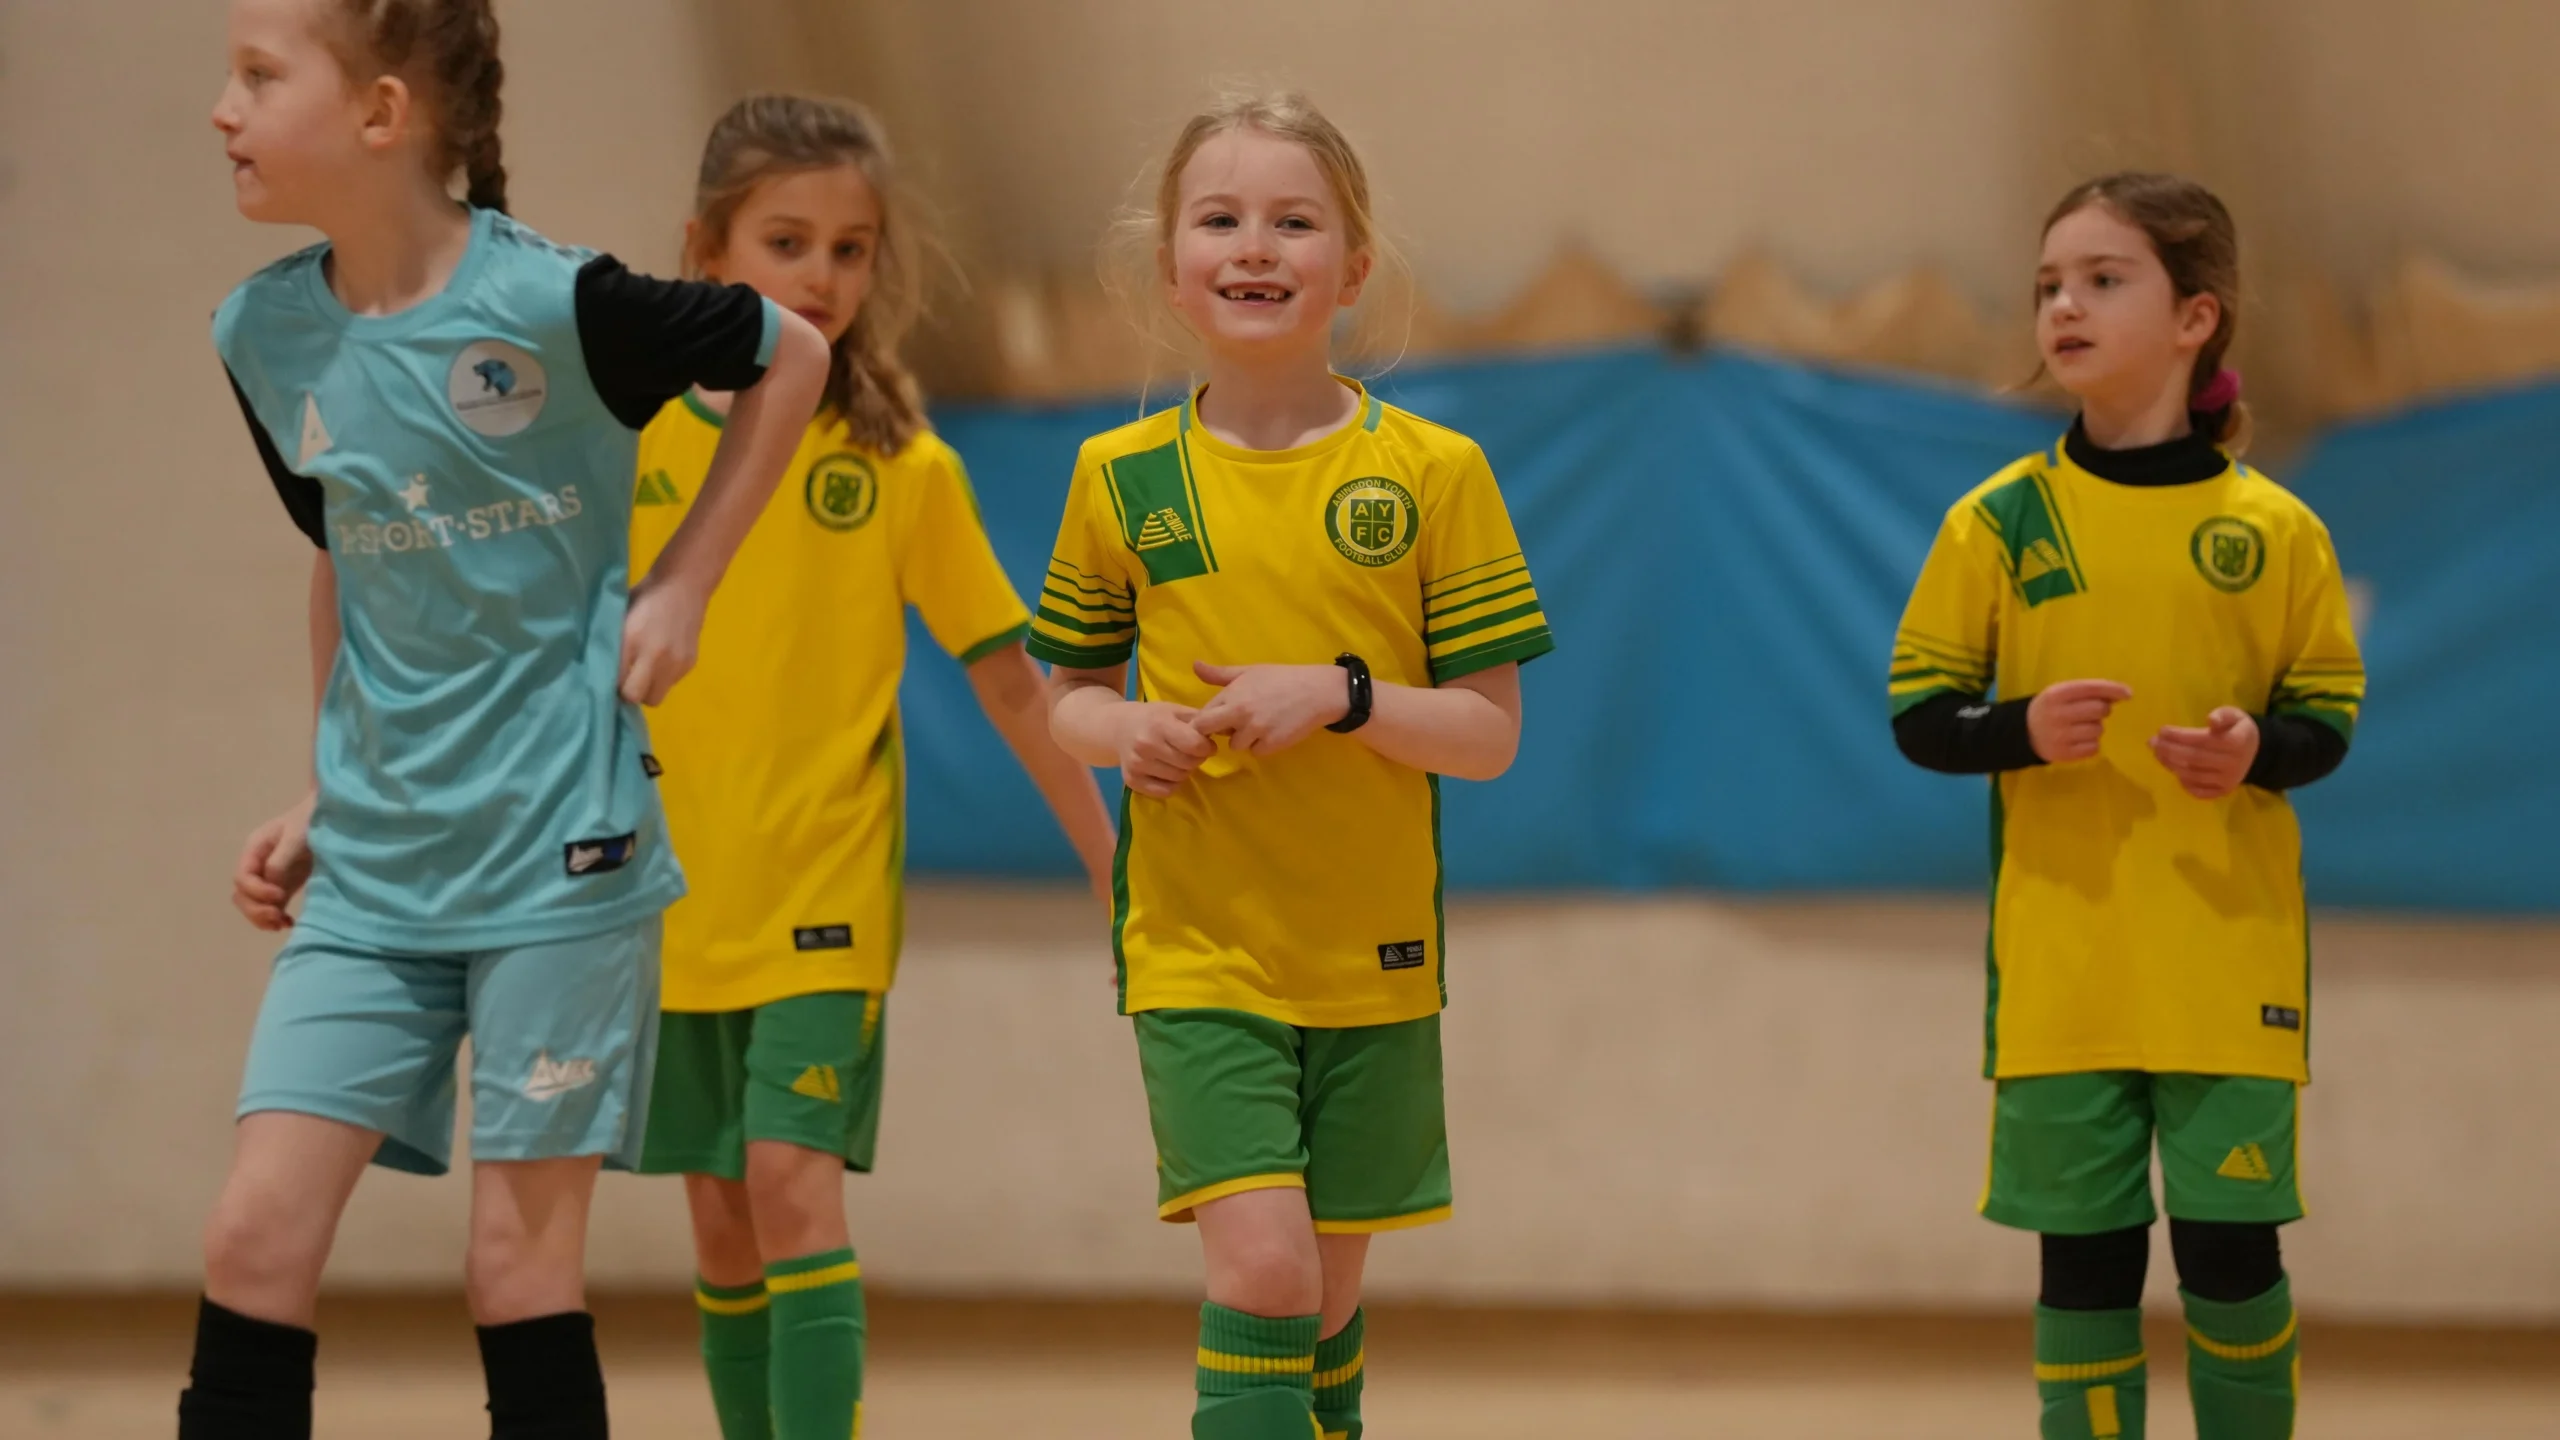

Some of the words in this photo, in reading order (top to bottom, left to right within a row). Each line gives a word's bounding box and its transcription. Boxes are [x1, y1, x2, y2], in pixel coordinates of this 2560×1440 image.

[1332, 479, 1381, 507] ABINGDON
[1385, 481, 1413, 510] YOUTH
[1355, 502, 1369, 517] A
[1378, 503, 1391, 517] Y
[1157, 506, 1193, 543] PENDLE
[1356, 526, 1367, 541] F
[1377, 527, 1390, 543] C
[1334, 537, 1383, 565] FOOTBALL
[1384, 541, 1408, 562] CLUB
